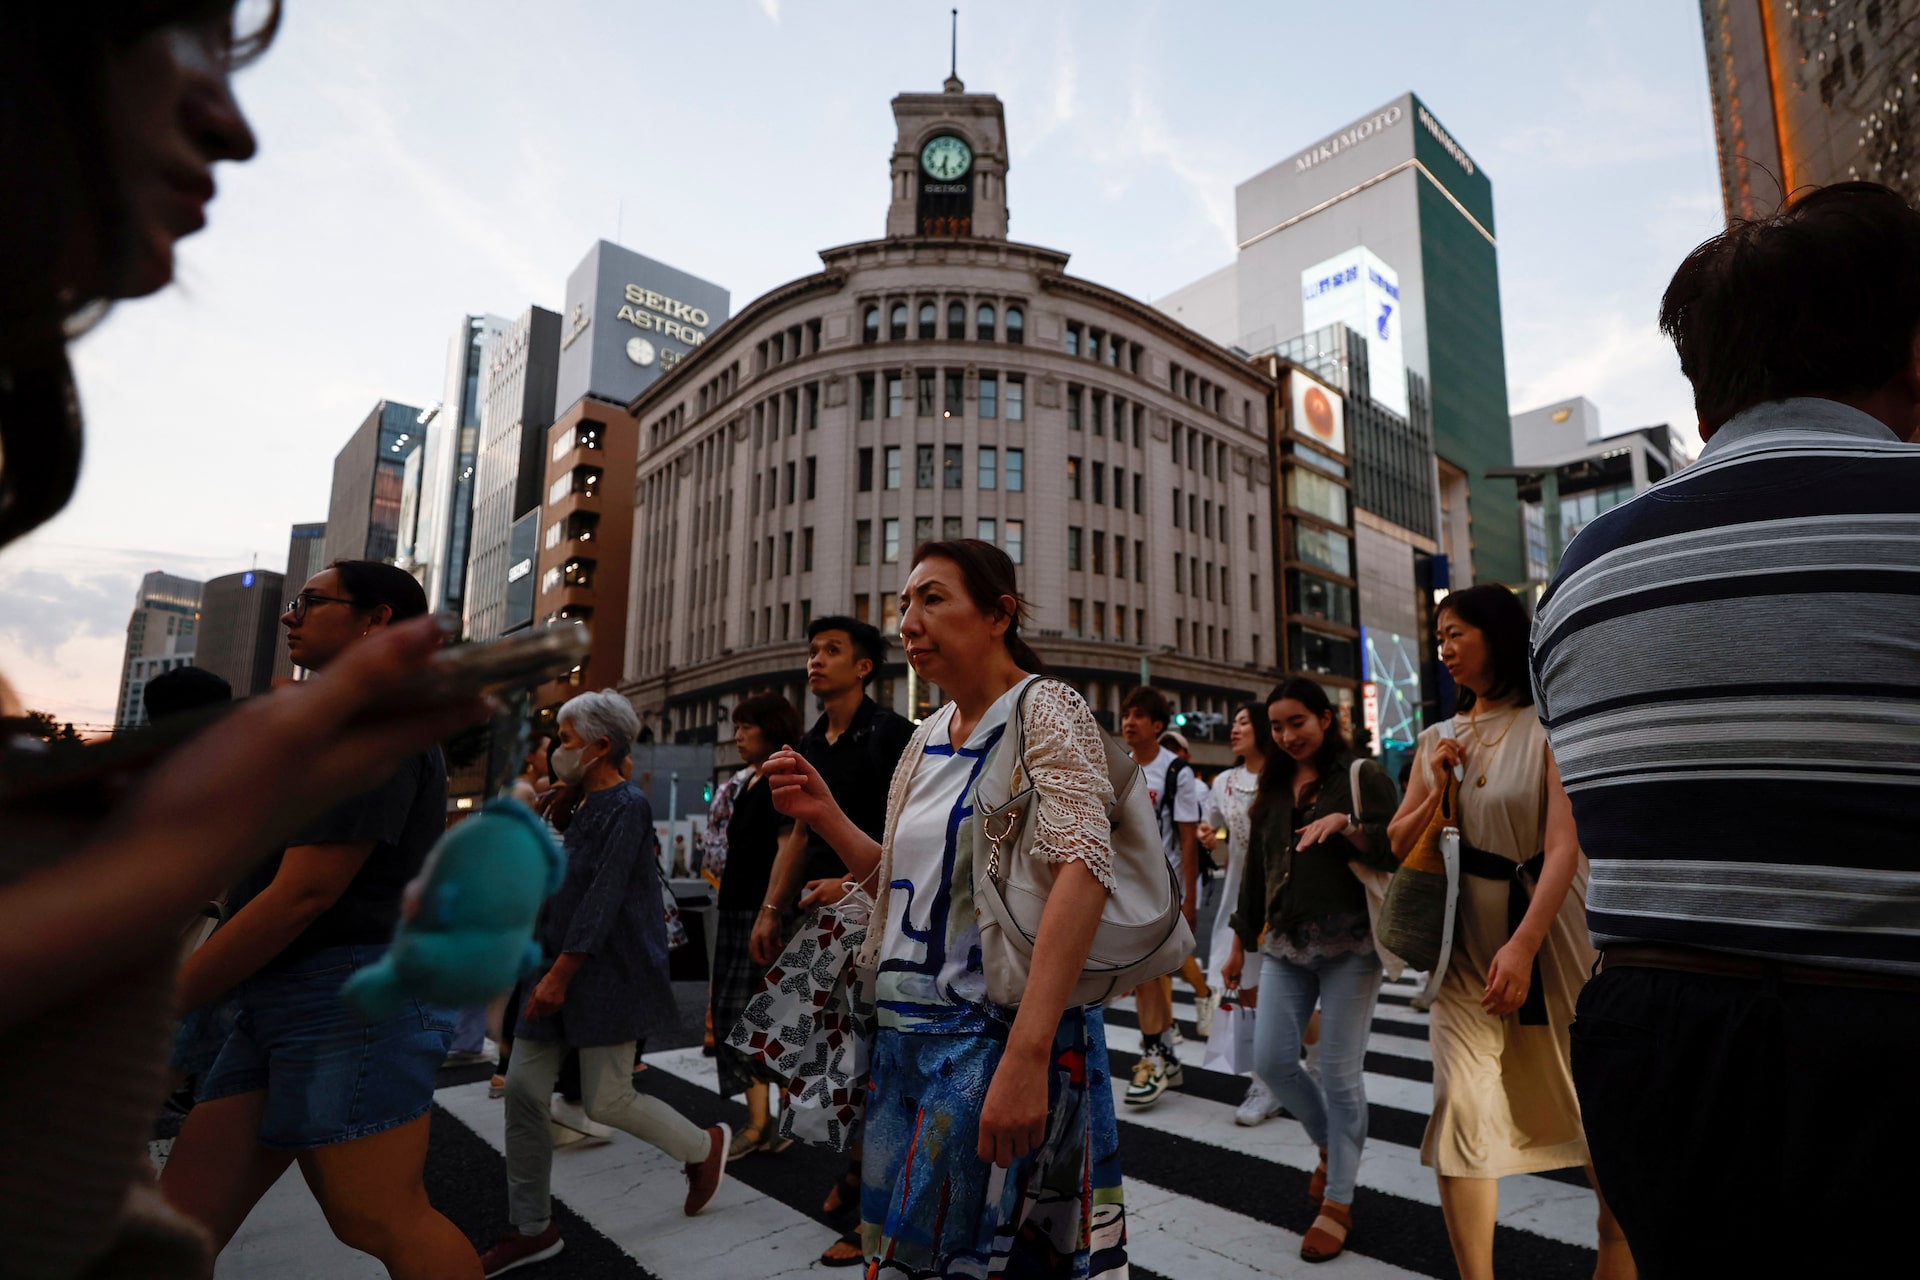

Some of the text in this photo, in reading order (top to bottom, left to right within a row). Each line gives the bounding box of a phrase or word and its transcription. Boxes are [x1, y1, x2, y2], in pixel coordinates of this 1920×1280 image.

[1295, 106, 1402, 172] MIKIMOTO
[924, 184, 967, 193] SEIKO
[625, 283, 709, 328] SEIKO
